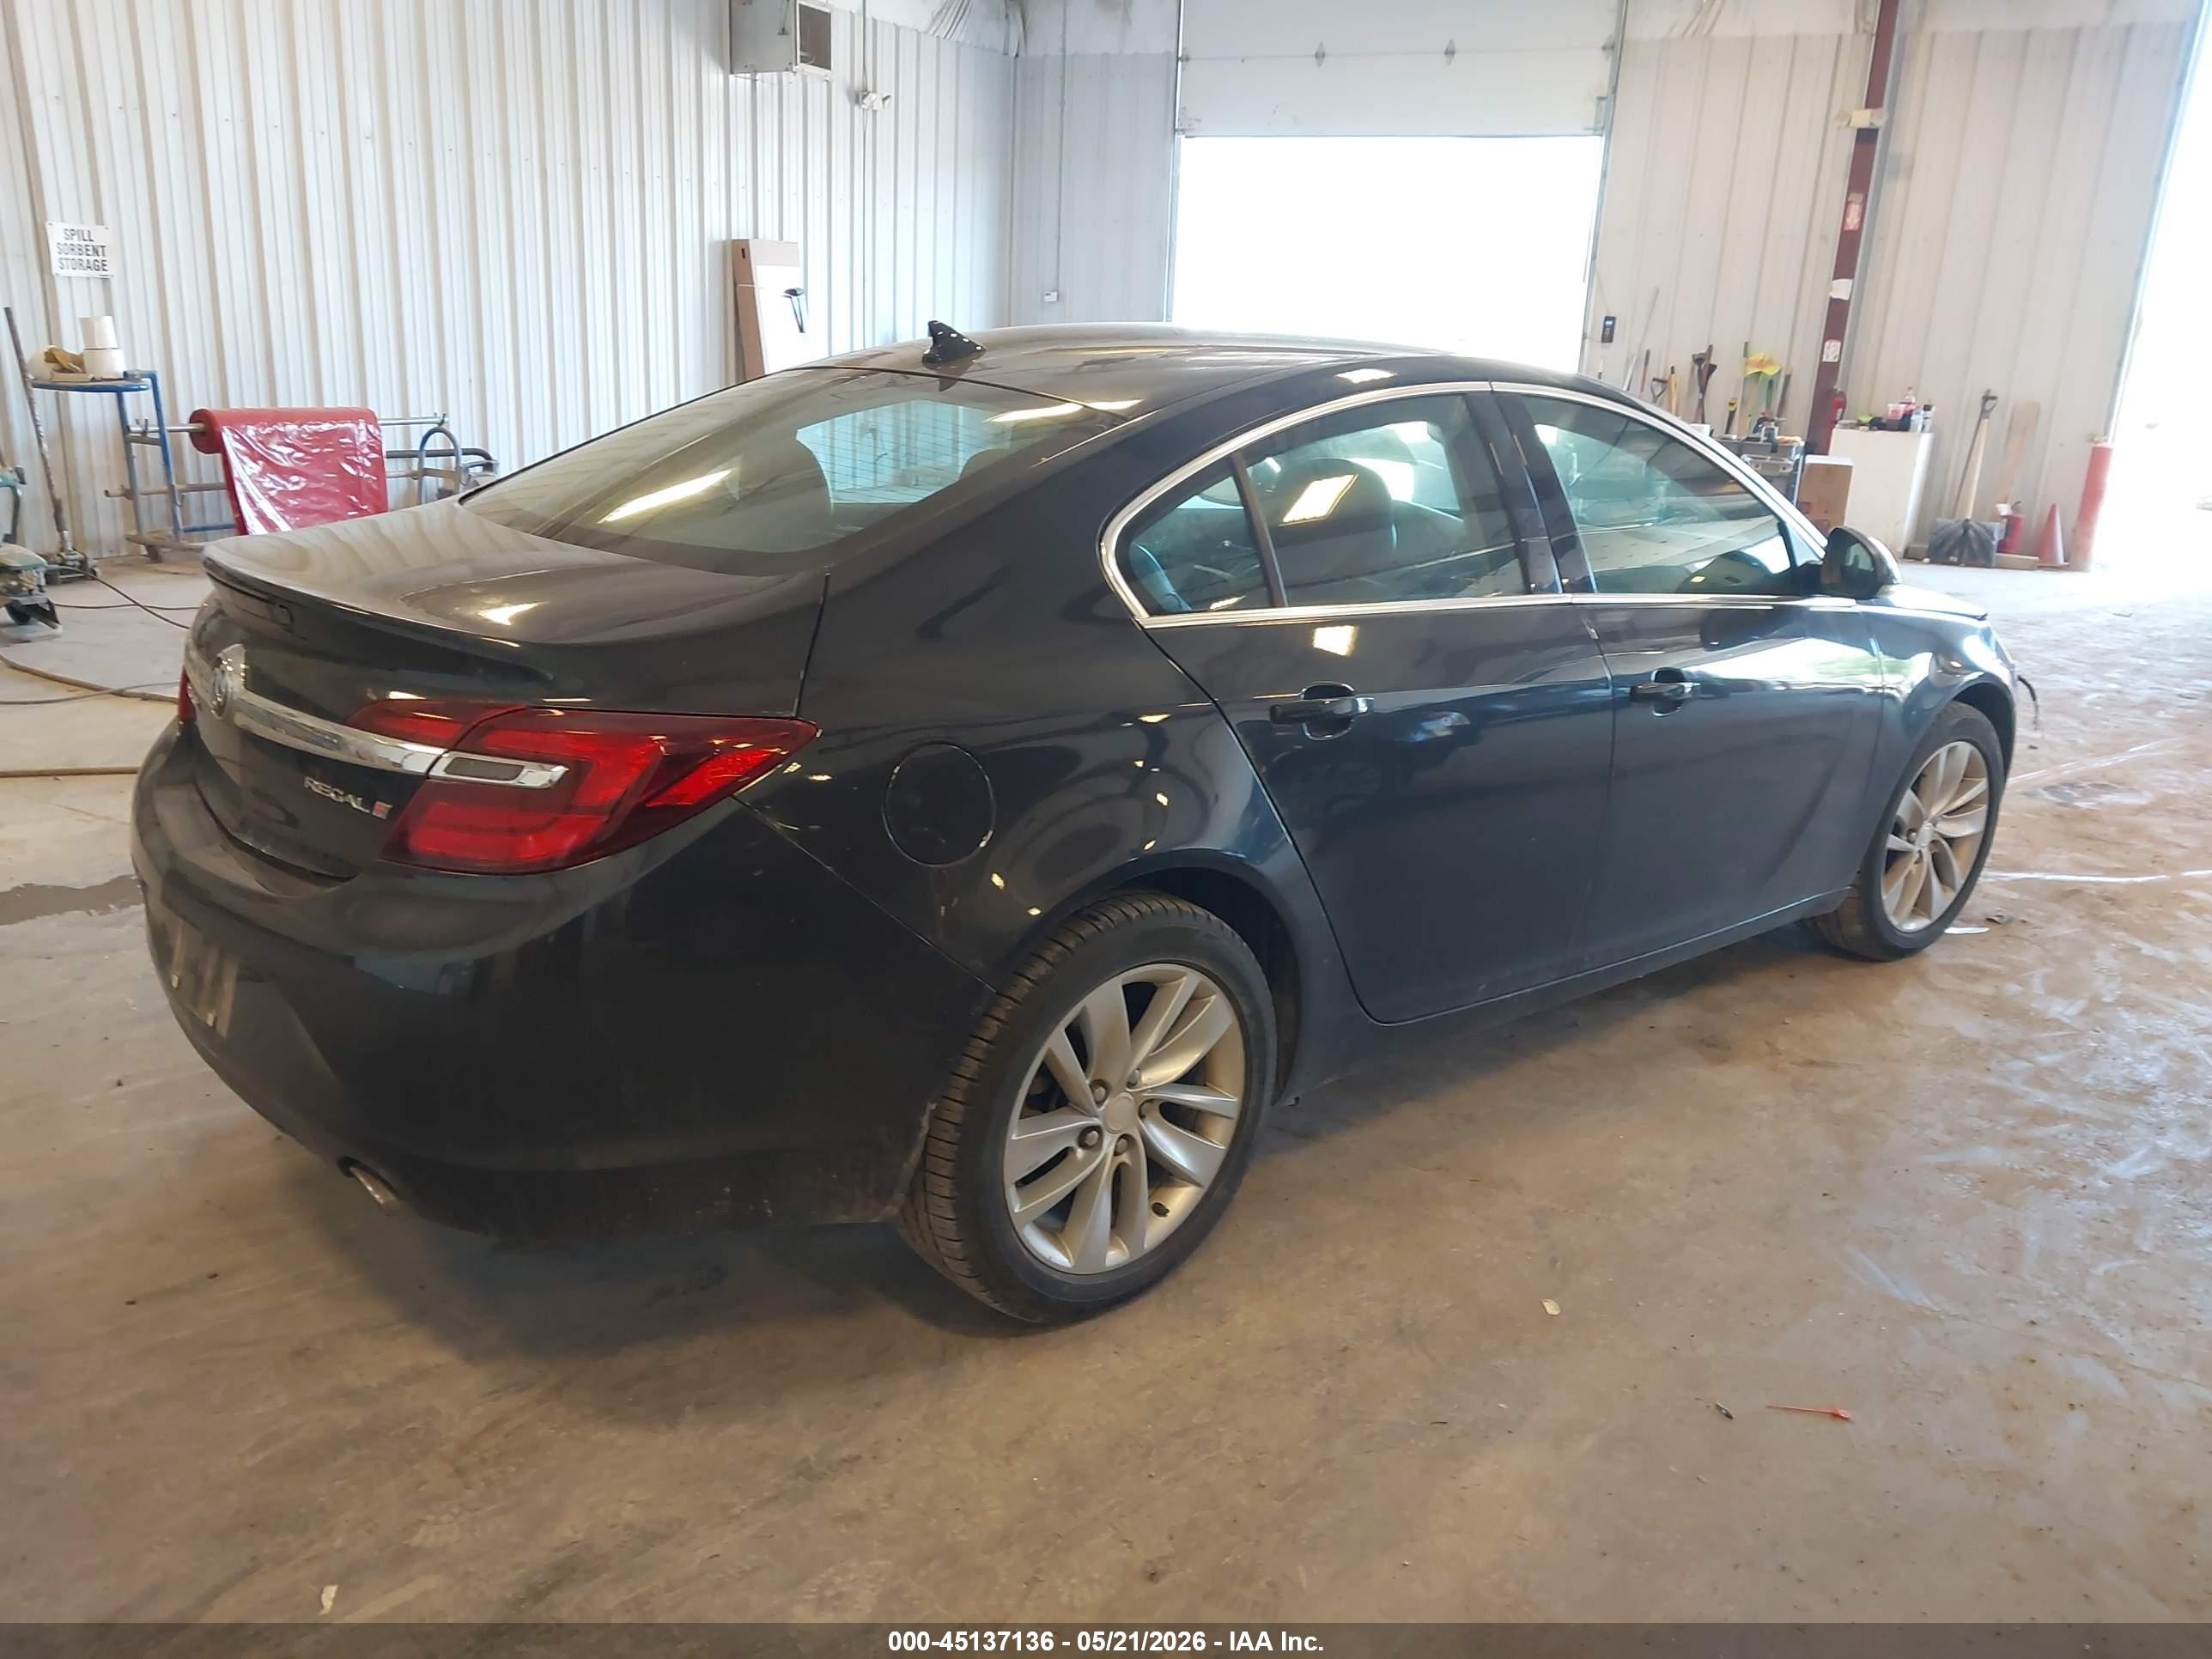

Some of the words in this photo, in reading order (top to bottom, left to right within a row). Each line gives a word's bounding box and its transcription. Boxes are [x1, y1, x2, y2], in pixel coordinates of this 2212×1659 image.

[64, 228, 94, 242] SPILL
[57, 242, 106, 257] SORBENT
[58, 257, 109, 272] STORAGE
[304, 775, 370, 813] REGAL
